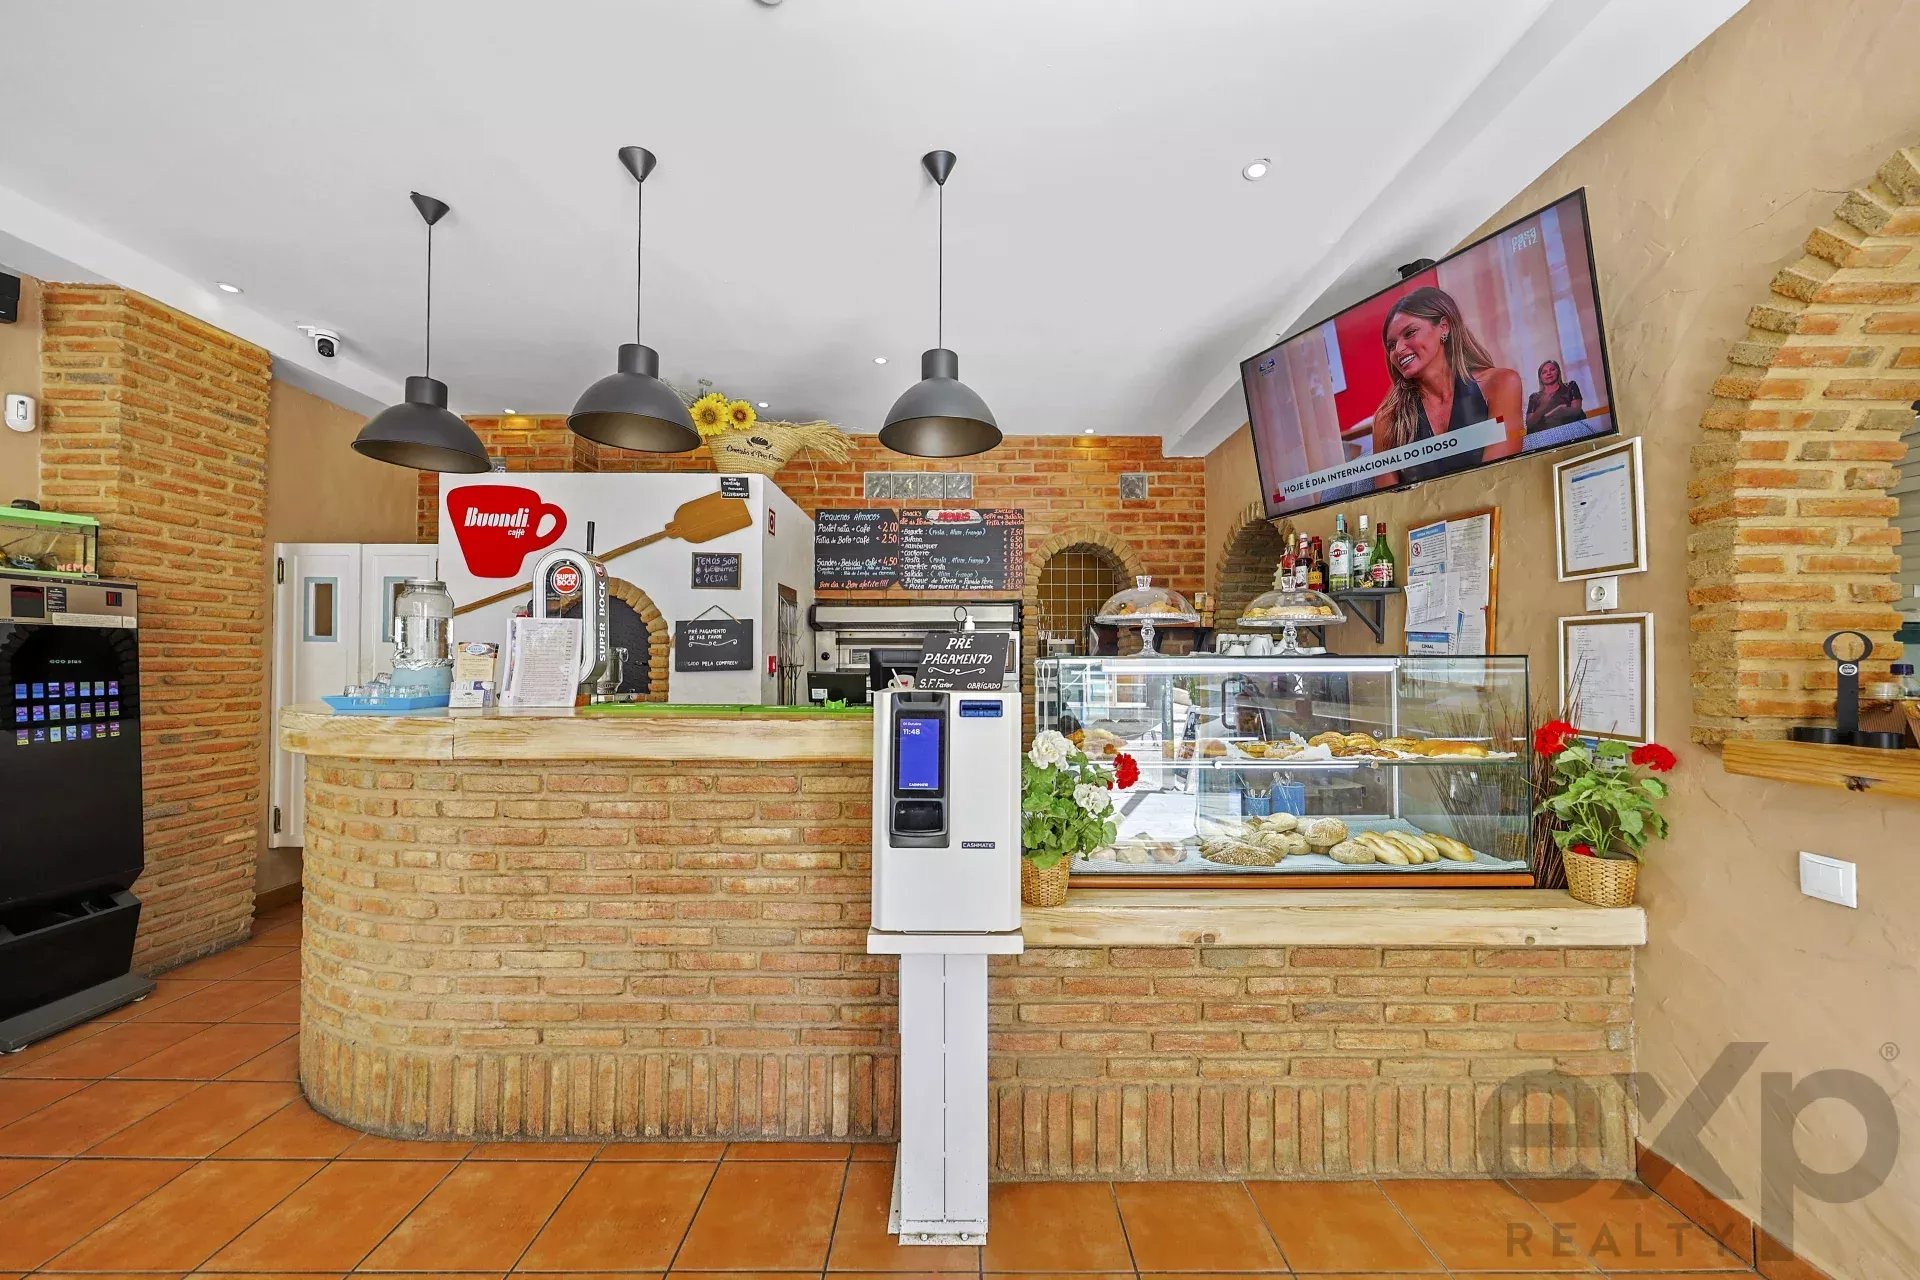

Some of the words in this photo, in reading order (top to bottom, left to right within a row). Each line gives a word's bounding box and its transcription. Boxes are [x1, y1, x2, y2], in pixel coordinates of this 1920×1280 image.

[1284, 482, 1304, 495] HOJE
[1306, 478, 1311, 487] É
[1312, 476, 1327, 487] DIA
[1328, 454, 1402, 482] INTERNACIONAL
[1404, 449, 1420, 460] DO
[1422, 438, 1458, 455] IDOSO
[464, 507, 530, 528] Buondi
[819, 511, 850, 522] Pequenos
[507, 528, 525, 538] caffè
[818, 523, 837, 533] Pastel
[837, 523, 850, 533] nata
[856, 524, 871, 533] Café
[816, 535, 830, 544] Fatia
[837, 535, 851, 544] Bolo
[856, 536, 870, 545] Café
[696, 557, 720, 565] TEMOS
[816, 558, 837, 567] Sandes
[840, 558, 861, 567] Bebida
[56, 563, 94, 573] NEMO
[946, 635, 975, 650] PRÉ
[921, 653, 993, 665] PAGAMENTO
